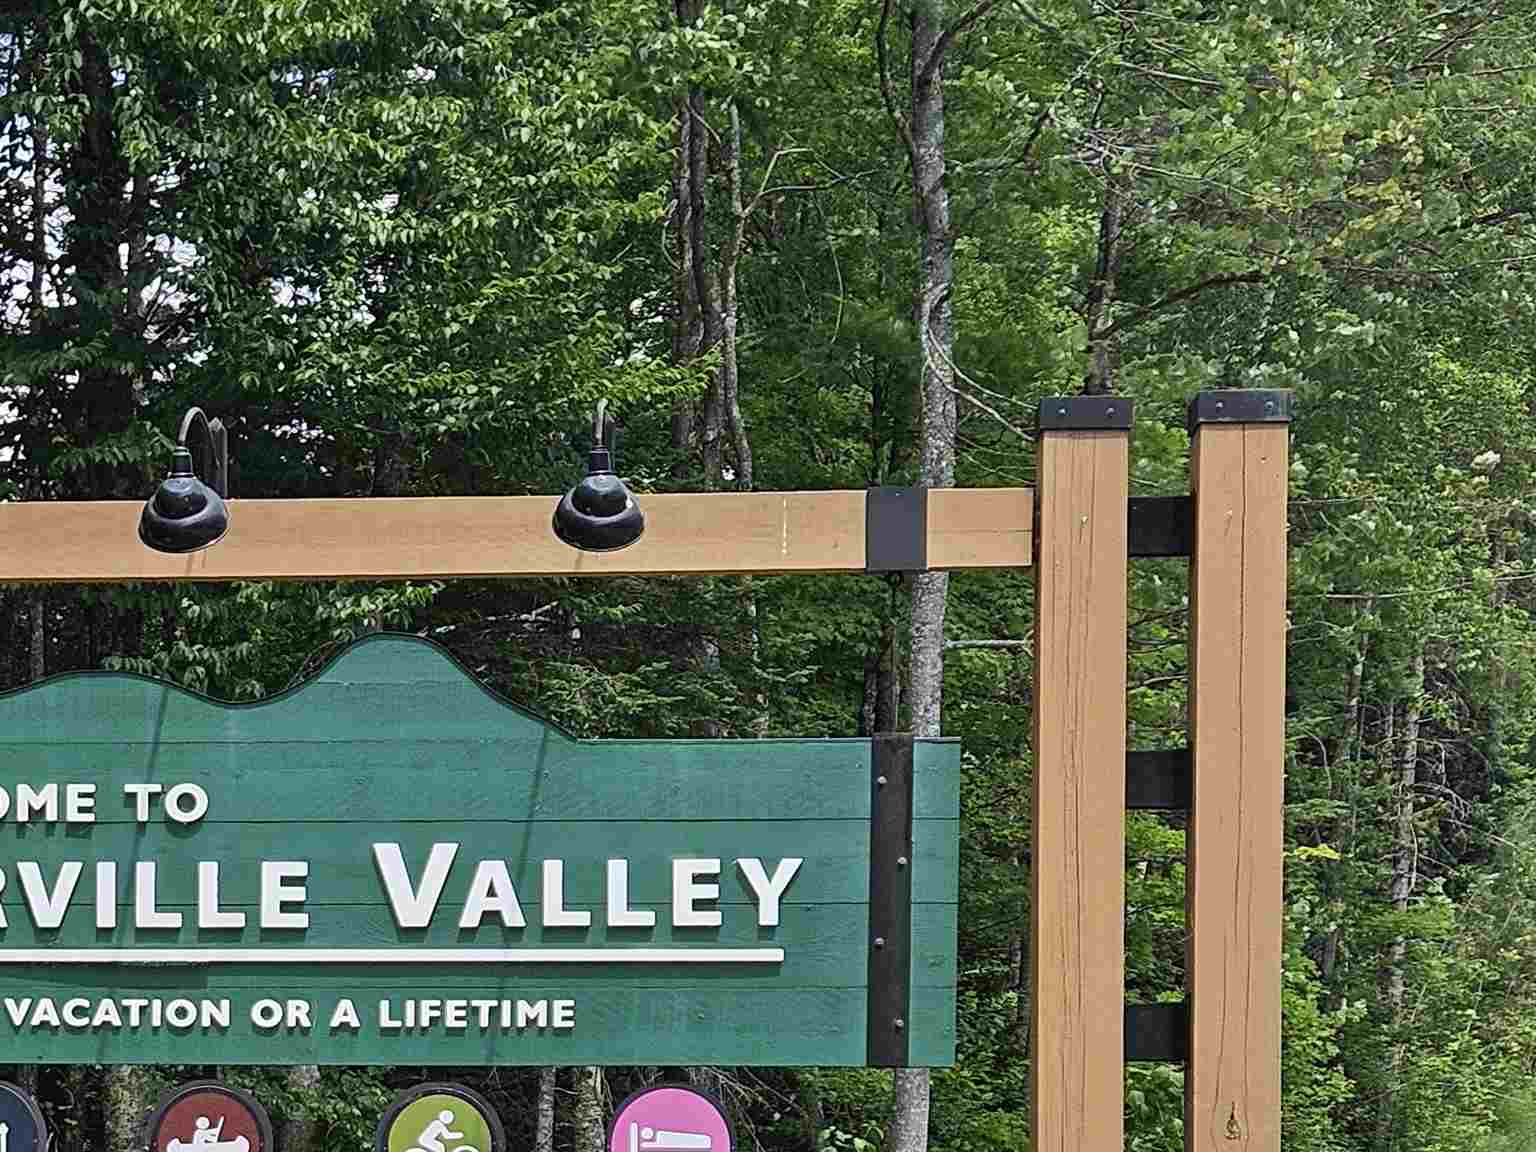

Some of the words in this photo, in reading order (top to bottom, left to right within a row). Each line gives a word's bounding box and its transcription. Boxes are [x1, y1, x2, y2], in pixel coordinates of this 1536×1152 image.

[124, 782, 209, 823] TO
[372, 842, 803, 928] VALLEY
[4, 997, 230, 1028] VACATION
[250, 998, 312, 1029] OR
[329, 998, 362, 1029] A
[379, 998, 576, 1029] LIFETIME
